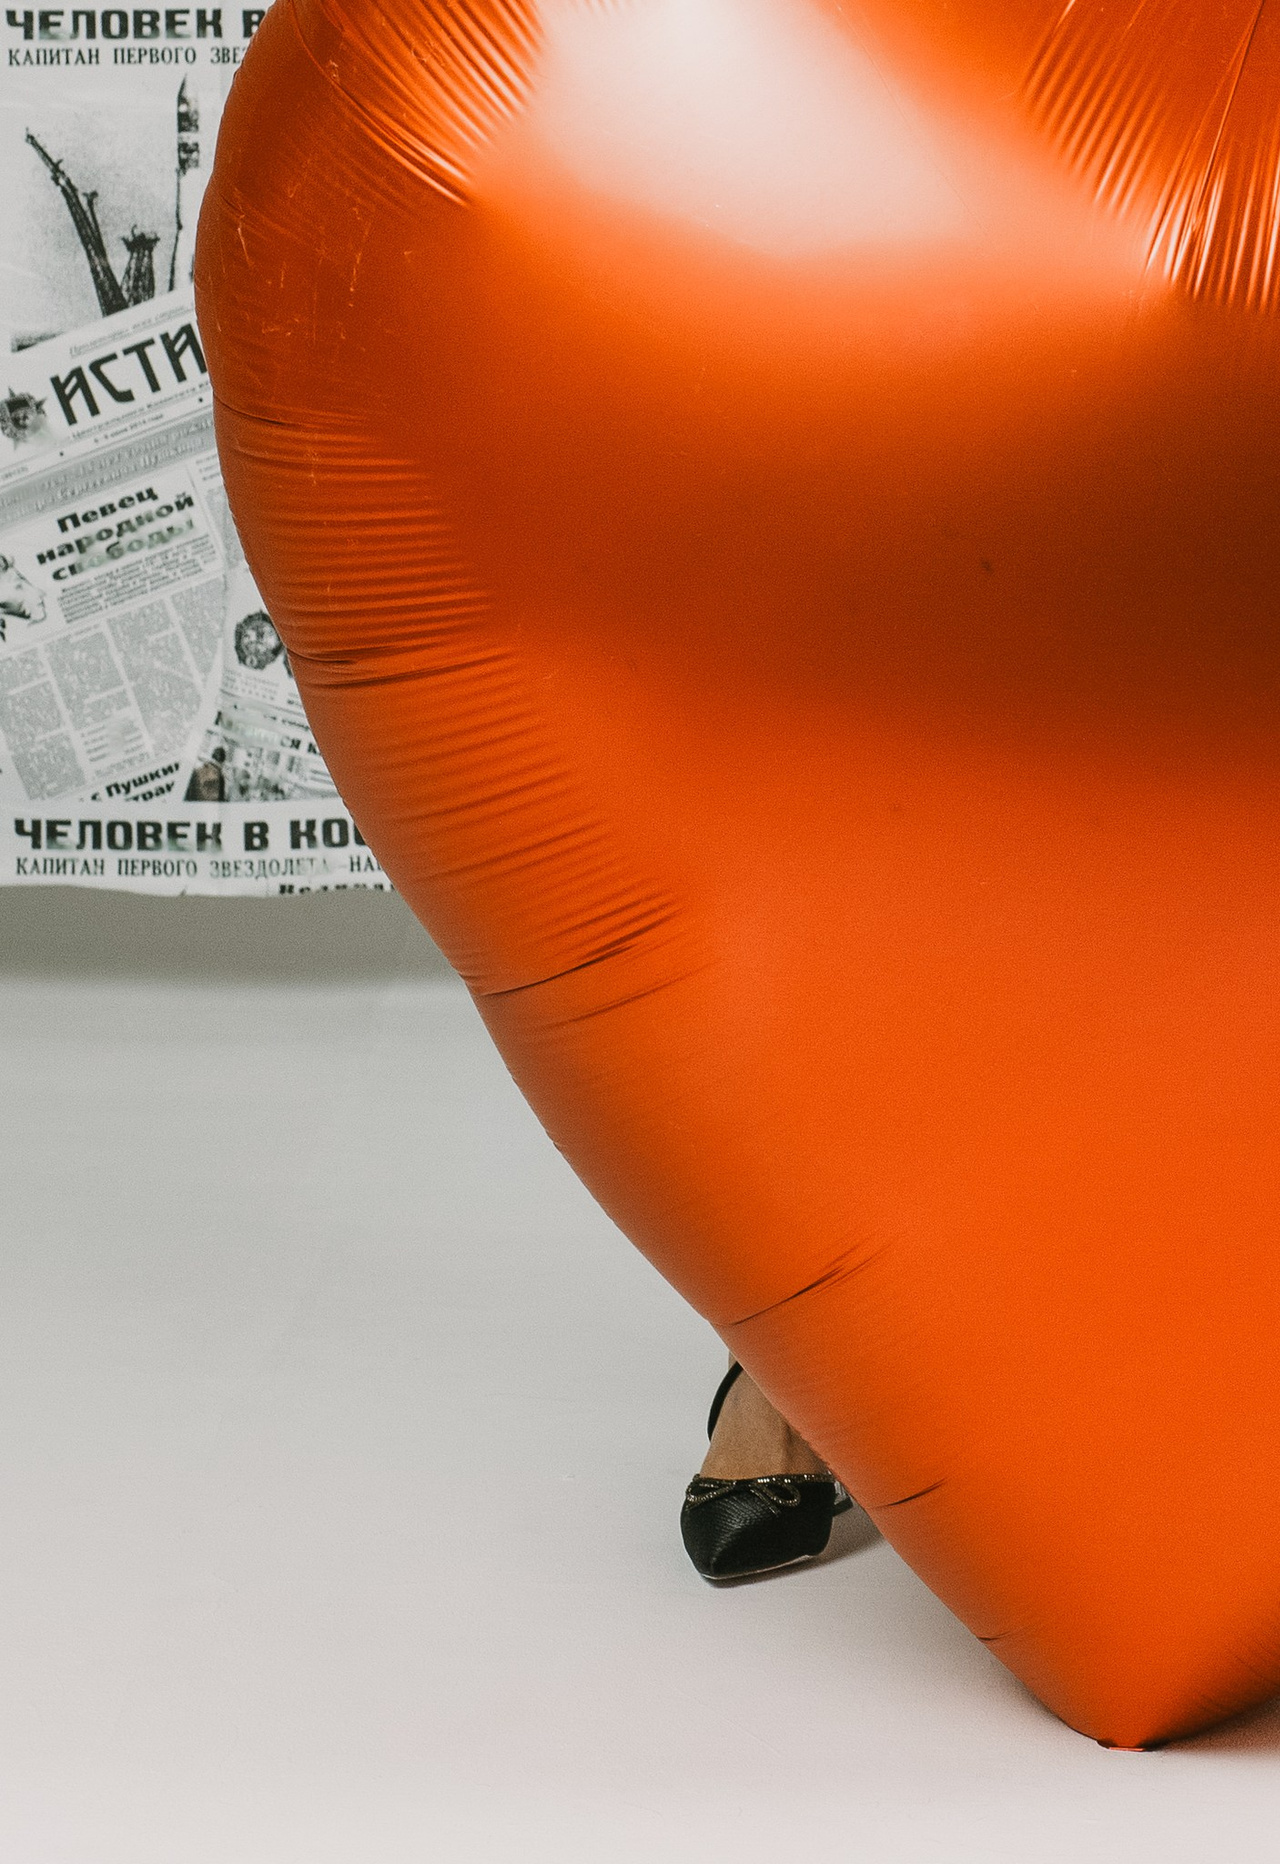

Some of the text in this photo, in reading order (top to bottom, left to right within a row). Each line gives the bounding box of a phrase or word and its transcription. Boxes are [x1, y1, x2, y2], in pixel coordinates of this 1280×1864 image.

[5, 9, 223, 40] ЧЕЛОВЕК
[8, 47, 248, 67] КАПИТАН ПЕРВОГО ЗВЕ
[56, 487, 160, 533] Певец
[14, 818, 223, 852] ЧЕЛОВЕК
[243, 820, 270, 852] В
[15, 856, 106, 877] КАПИТАН
[117, 858, 198, 878] ПЕРВОГО
